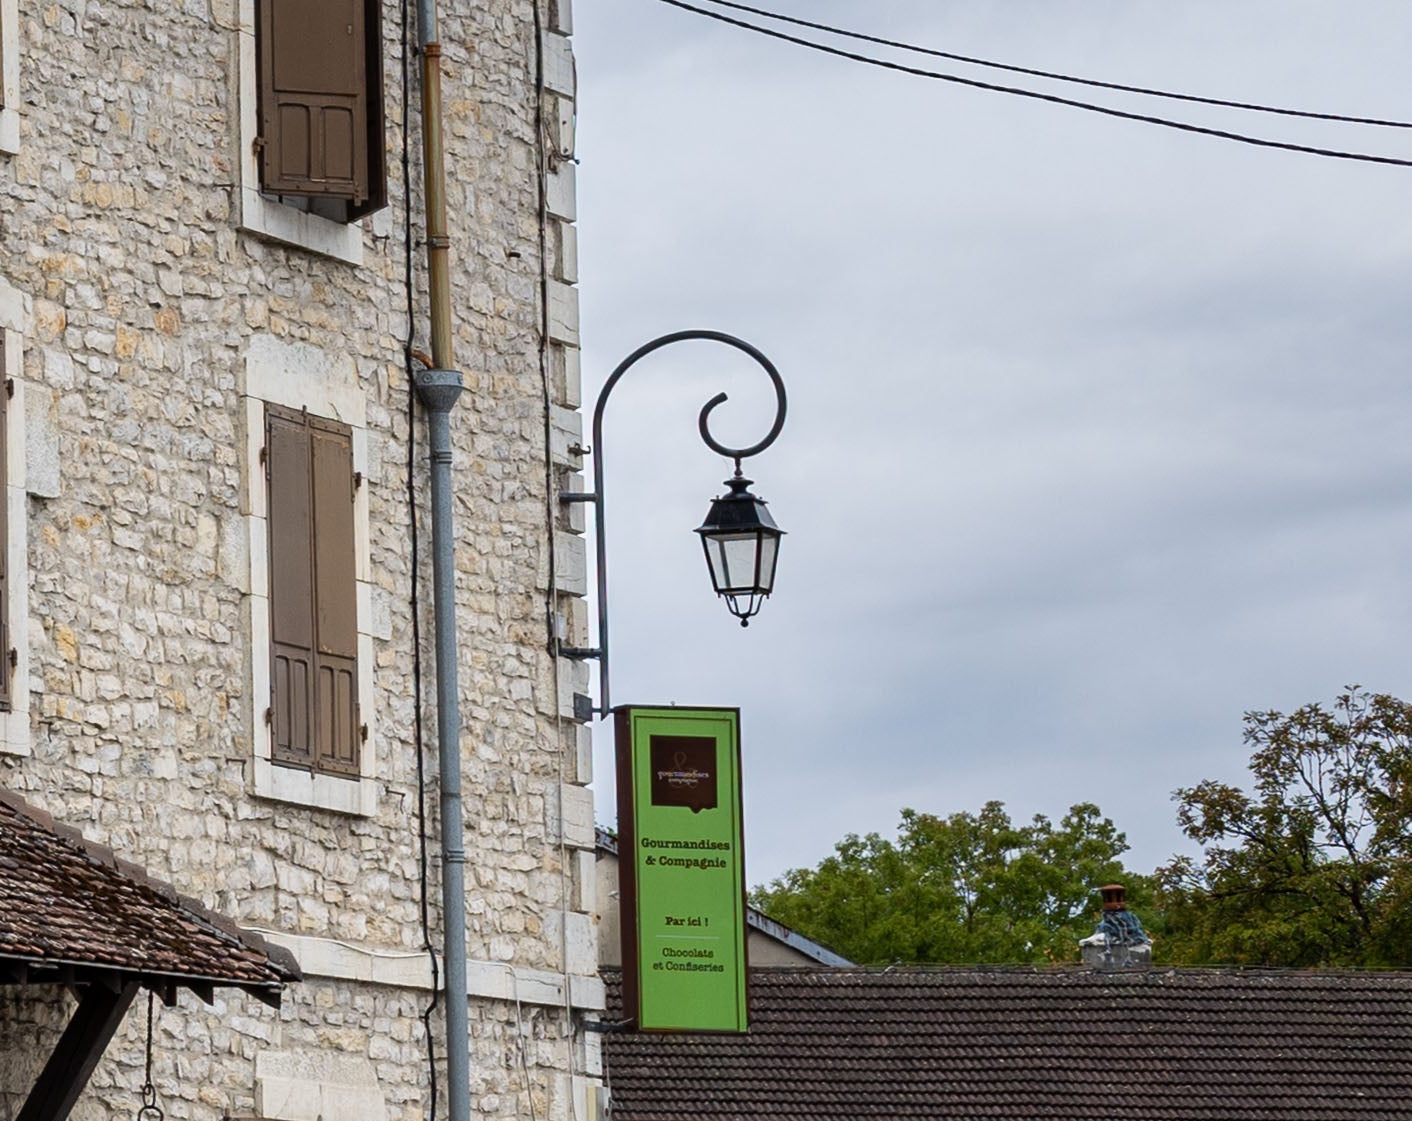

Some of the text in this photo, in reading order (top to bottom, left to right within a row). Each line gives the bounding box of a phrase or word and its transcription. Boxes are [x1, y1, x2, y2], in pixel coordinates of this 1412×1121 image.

[641, 837, 730, 851] Gourmandises
[645, 855, 727, 870] & Compagnie
[665, 916, 709, 927] Par ici !
[662, 947, 714, 958] Chocolats
[652, 961, 724, 972] et Confiseries
